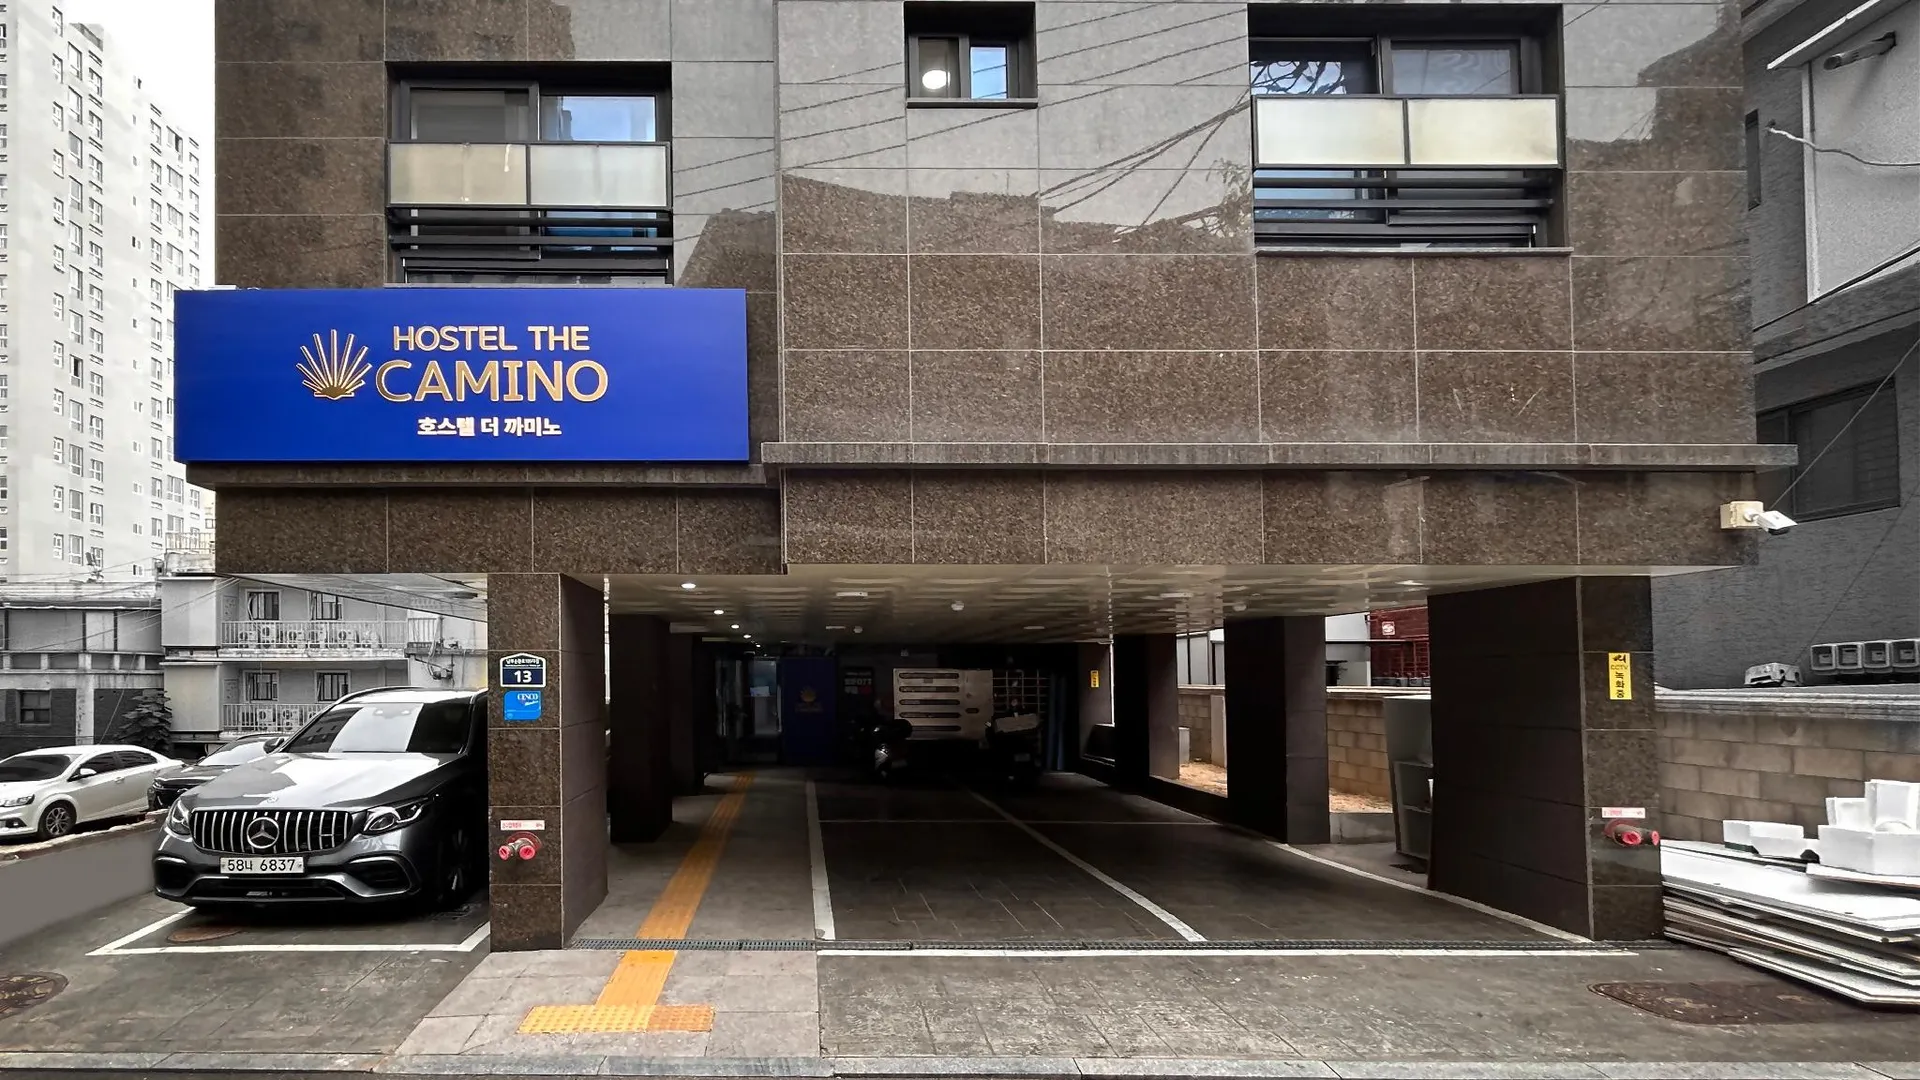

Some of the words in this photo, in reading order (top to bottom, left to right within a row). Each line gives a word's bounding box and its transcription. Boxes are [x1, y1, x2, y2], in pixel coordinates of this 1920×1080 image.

[393, 325, 517, 351] HOSTEL
[527, 325, 590, 351] THE
[375, 359, 609, 402] CAMINO
[417, 416, 476, 437] 호스텔
[480, 416, 499, 437] 더
[503, 416, 562, 437] 까미노
[514, 670, 532, 683] 13
[260, 859, 295, 871] 6837
